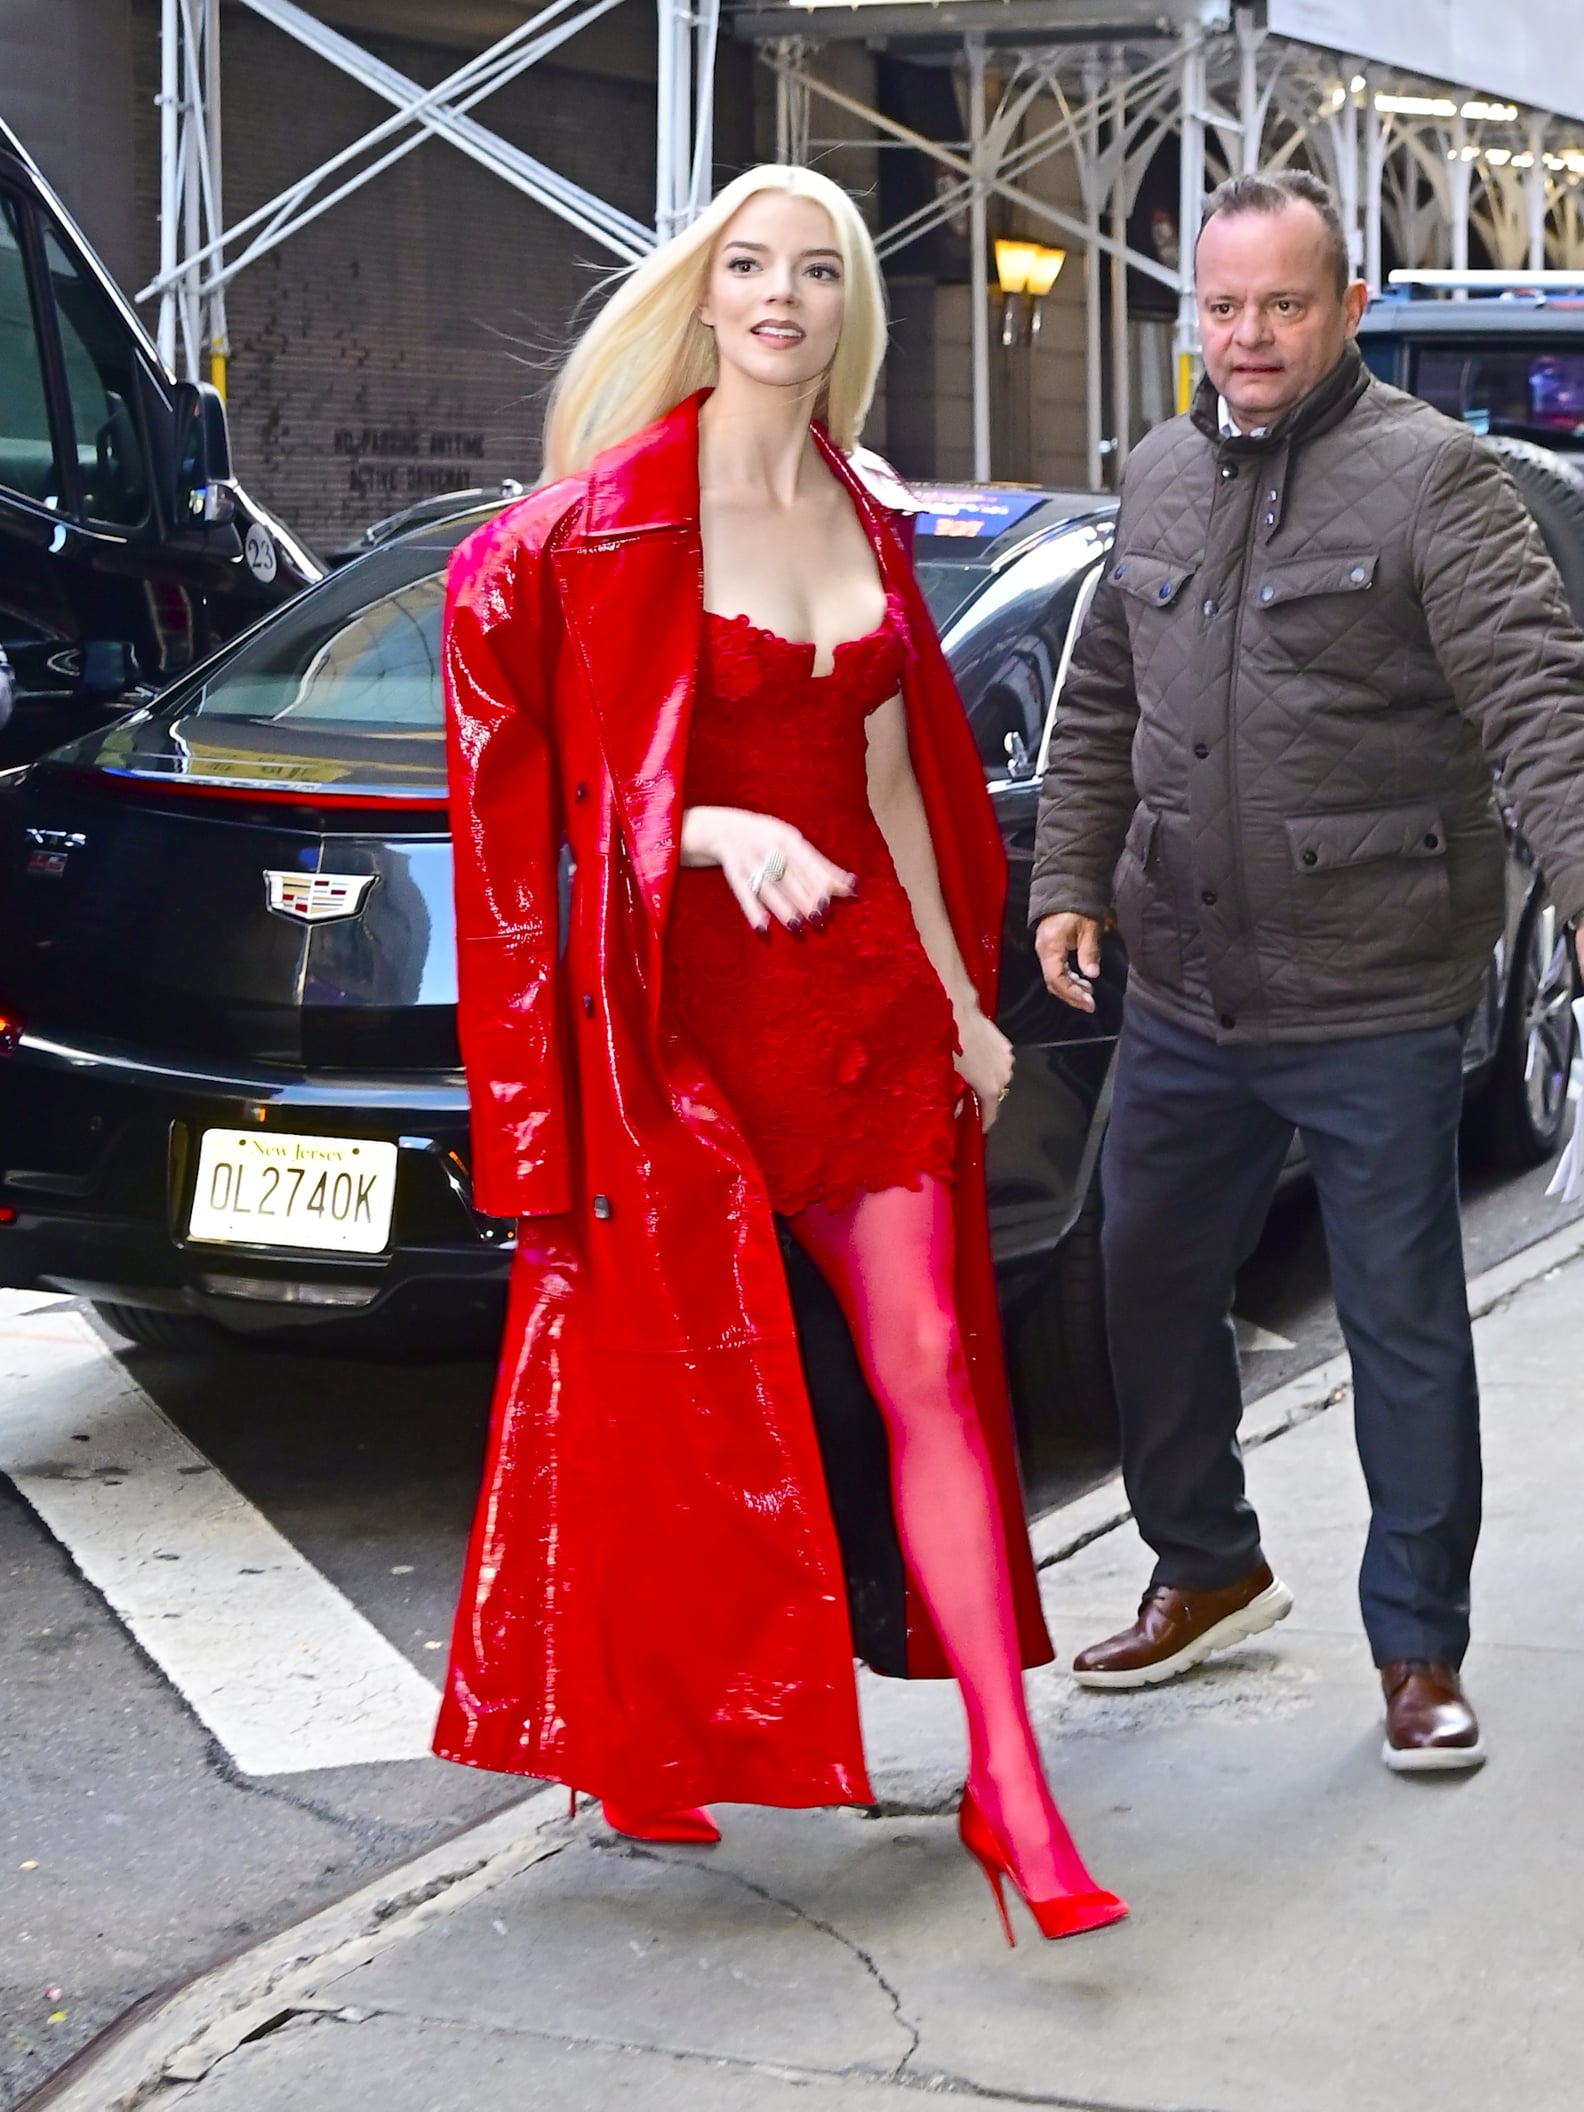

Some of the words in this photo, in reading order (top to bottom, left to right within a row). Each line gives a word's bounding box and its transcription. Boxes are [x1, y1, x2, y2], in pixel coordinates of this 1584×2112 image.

[248, 539, 274, 570] 23
[252, 1139, 288, 1158] New
[293, 1143, 344, 1162] Jersey
